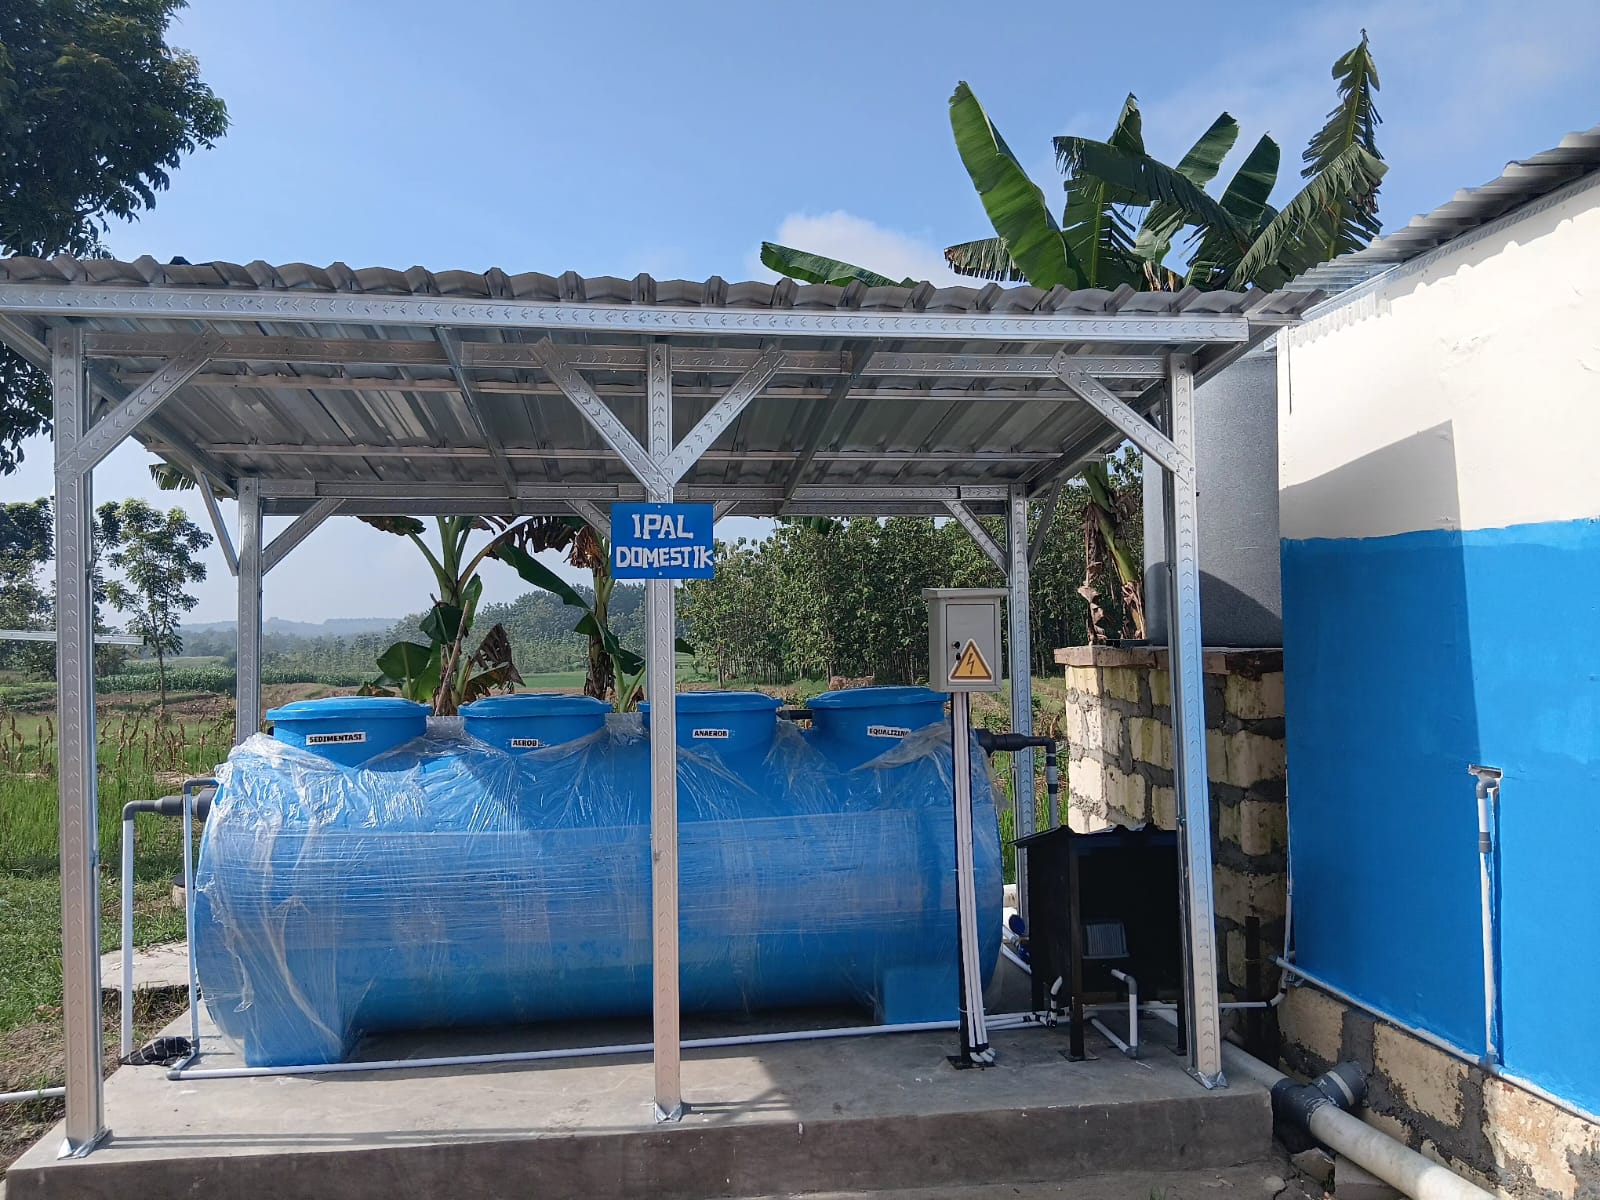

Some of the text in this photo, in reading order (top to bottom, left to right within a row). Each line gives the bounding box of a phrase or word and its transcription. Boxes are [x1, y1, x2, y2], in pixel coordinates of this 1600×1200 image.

[632, 514, 694, 539] IPAL
[616, 546, 713, 568] DOMESTIK
[309, 733, 362, 743] SEDIMENTASI
